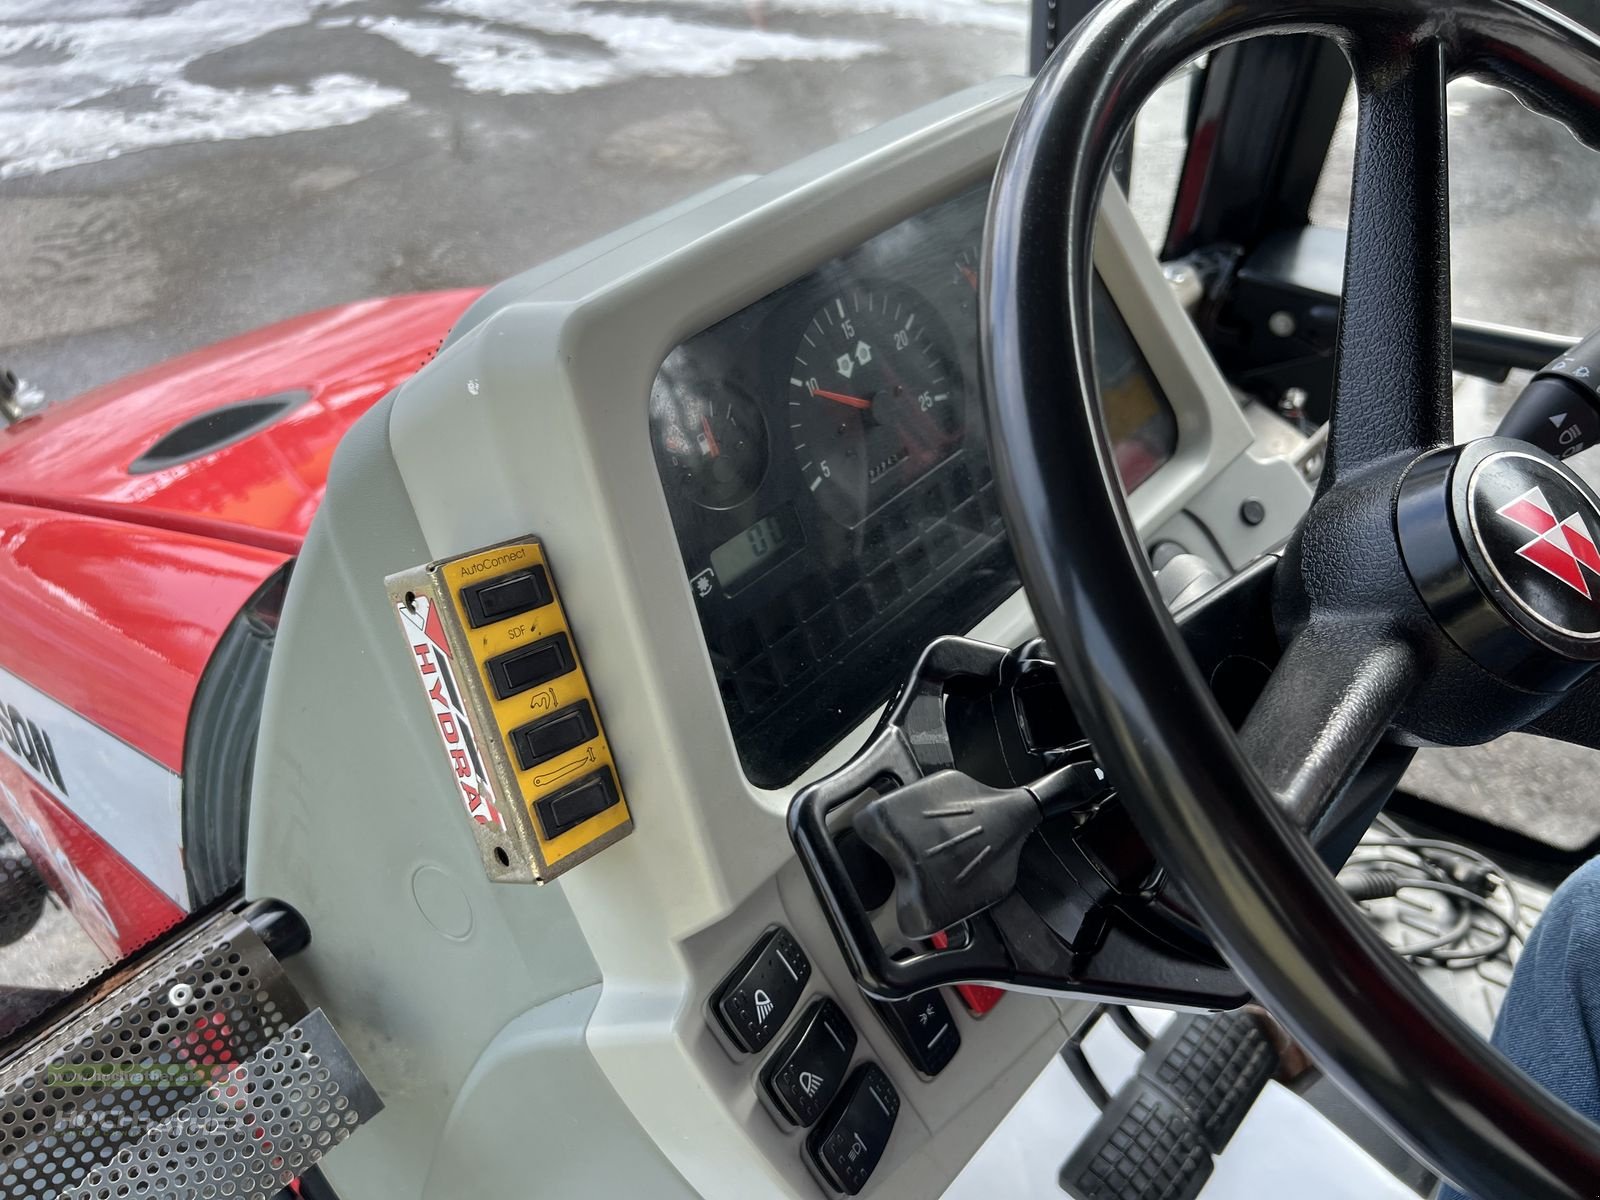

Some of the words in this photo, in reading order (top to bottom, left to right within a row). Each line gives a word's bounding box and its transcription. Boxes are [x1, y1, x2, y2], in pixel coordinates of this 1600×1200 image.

[841, 319, 855, 339] 15
[894, 332, 909, 351] 20
[805, 377, 820, 397] 10
[918, 391, 934, 412] 25
[820, 460, 831, 478] 5
[460, 548, 527, 577] AutoConnect
[507, 624, 526, 640] SDF
